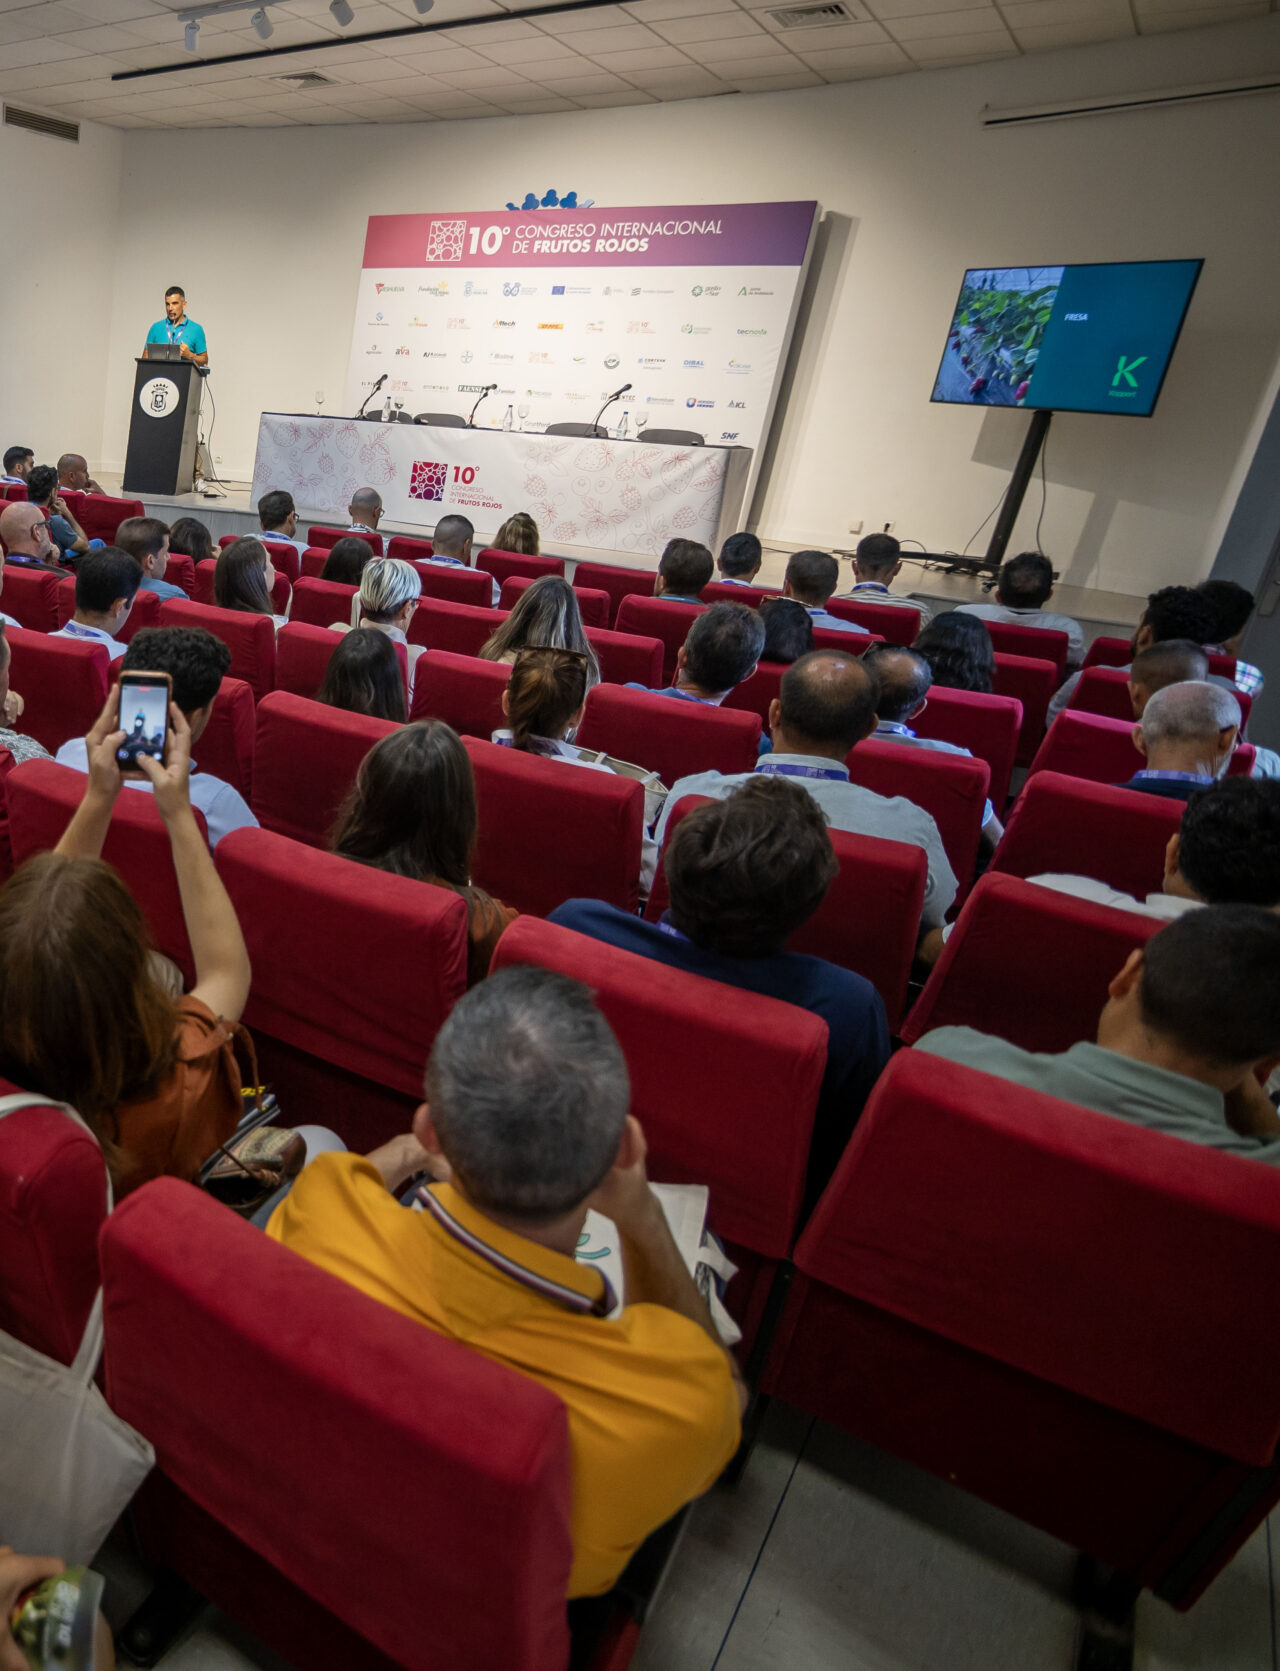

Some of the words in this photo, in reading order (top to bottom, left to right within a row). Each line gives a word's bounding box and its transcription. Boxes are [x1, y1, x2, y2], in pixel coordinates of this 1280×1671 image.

[515, 223, 596, 239] CONGRESO
[600, 220, 723, 236] INTERNACIONAL
[512, 240, 529, 254] DE
[533, 239, 591, 253] FRUTOS
[595, 238, 649, 253] ROJOS
[1064, 313, 1088, 321] FRESA
[721, 432, 740, 440] SNF
[452, 485, 484, 493] CONGRESO
[450, 491, 494, 502] INTERNACIONAL
[457, 498, 480, 506] FRUTOS
[482, 501, 502, 509] ROJOS
